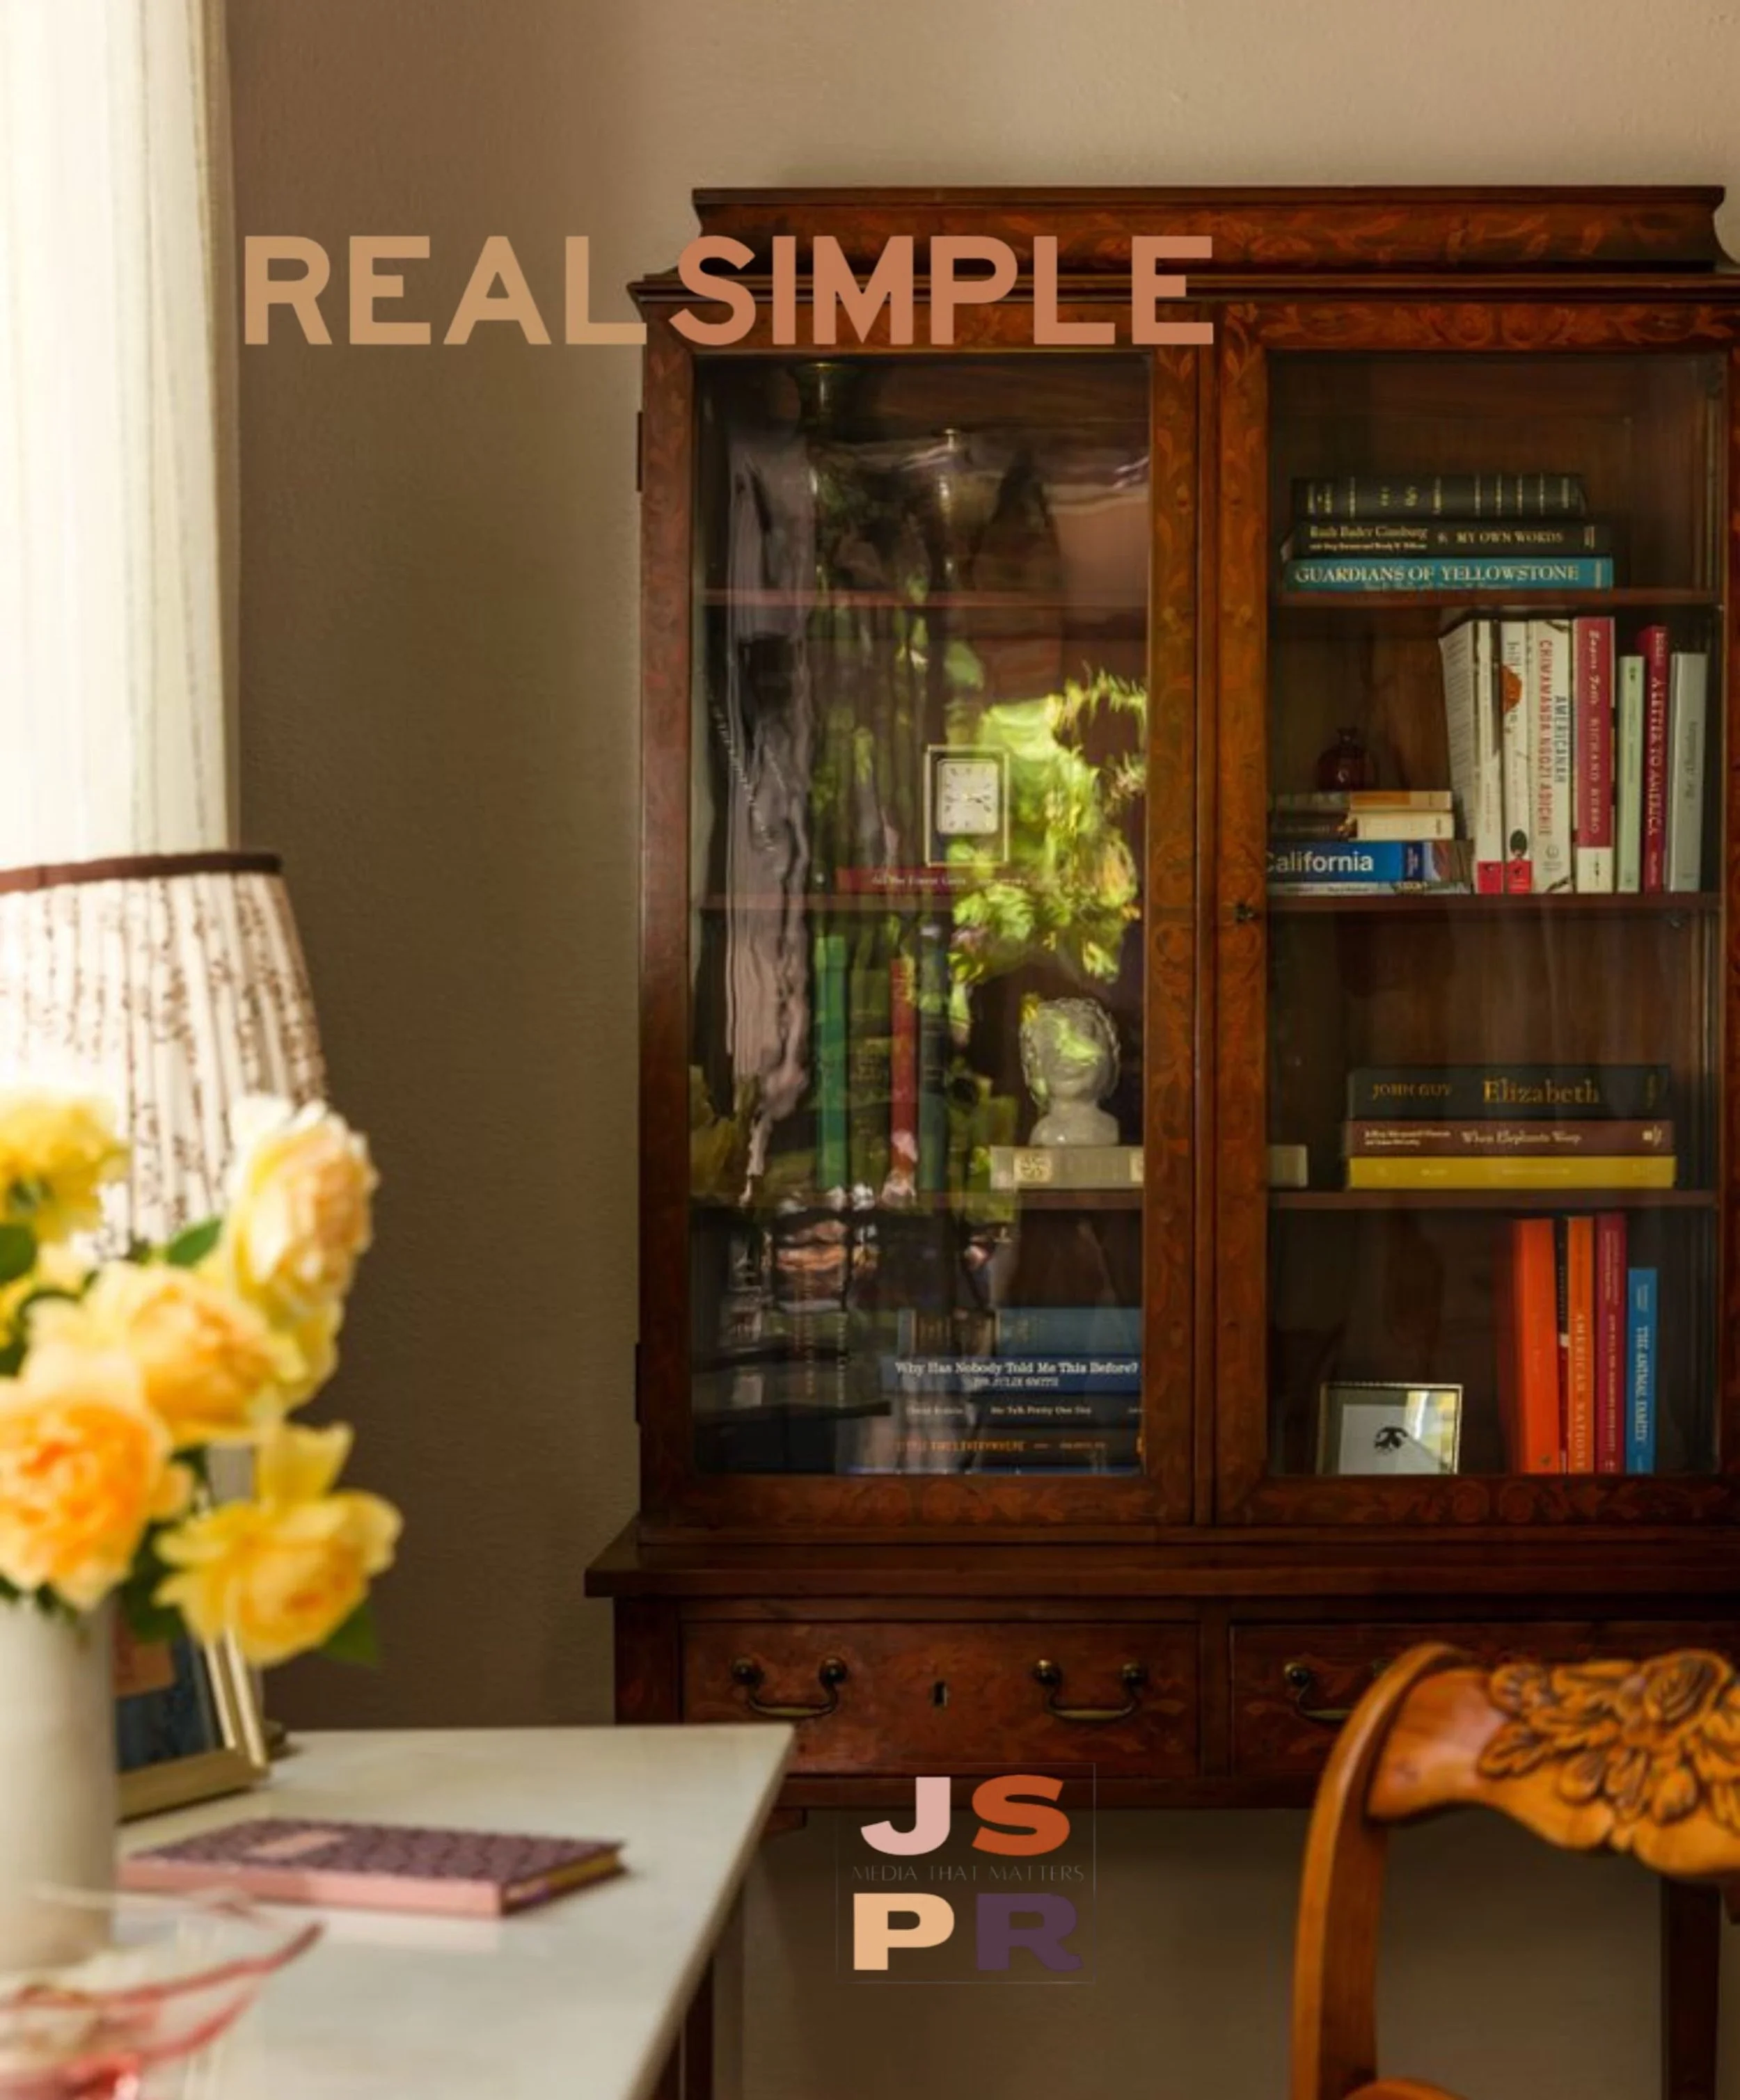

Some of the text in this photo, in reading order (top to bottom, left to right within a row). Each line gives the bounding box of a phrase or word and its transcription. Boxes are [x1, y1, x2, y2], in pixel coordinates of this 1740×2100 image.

[1456, 531, 1563, 543] MY OWN WORDS
[1295, 564, 1579, 583] GUARDIANS OF YELLOWSTONE
[1539, 639, 1553, 731] CHIMAMANDA
[1554, 695, 1568, 783] AMERICANAH
[1538, 783, 1553, 836] ADICHIE
[1647, 769, 1662, 836] AMERICA
[1373, 1083, 1453, 1100] JOHN GUY
[1483, 1077, 1599, 1104] Elizabeth
[895, 1362, 925, 1377] Why
[956, 1362, 1002, 1376] Nobody
[1005, 1362, 1034, 1374] Told
[1037, 1362, 1057, 1374] Me
[1059, 1362, 1086, 1374] This
[1089, 1362, 1139, 1374] Before?
